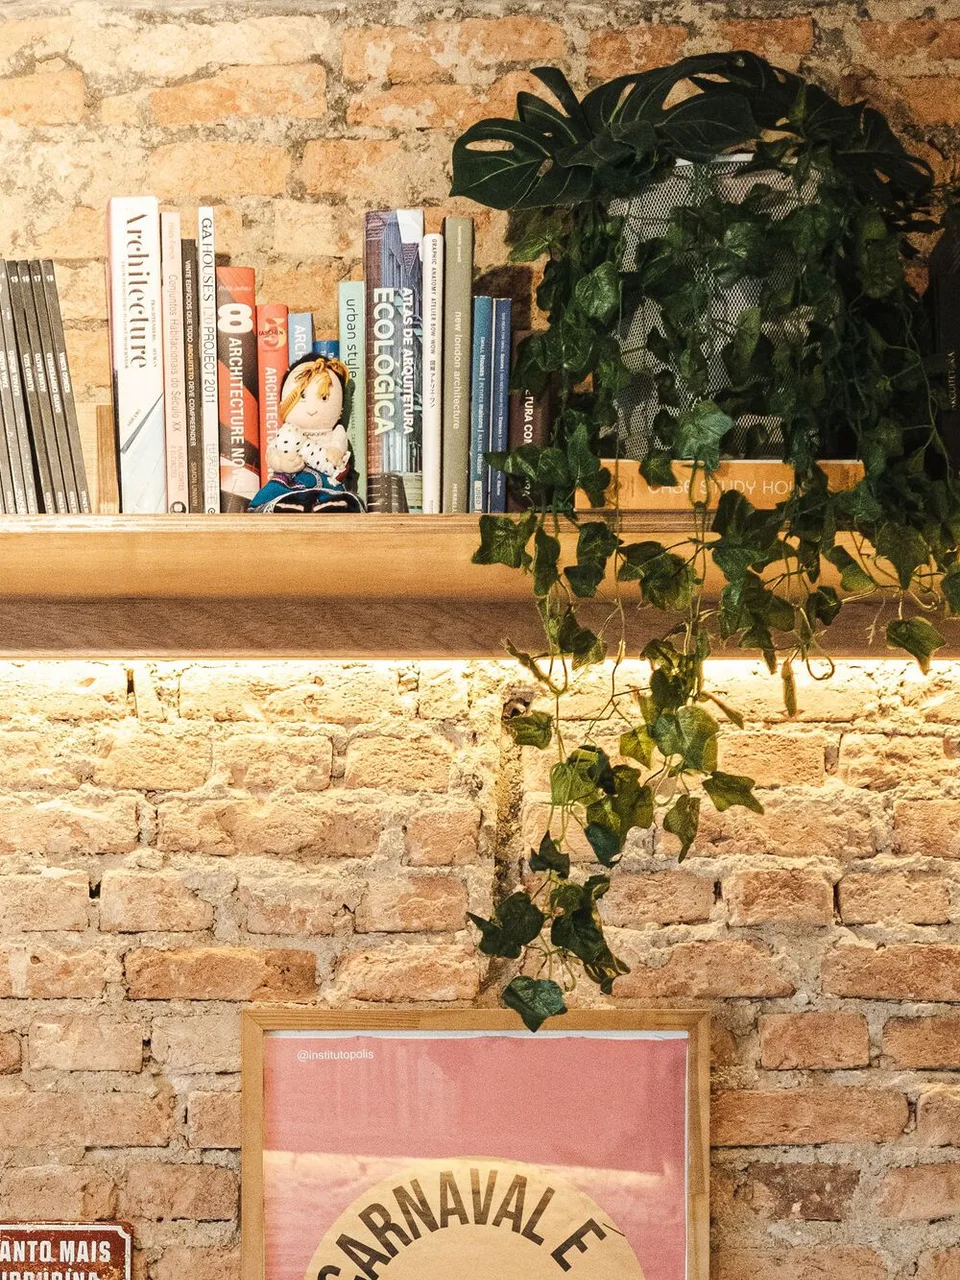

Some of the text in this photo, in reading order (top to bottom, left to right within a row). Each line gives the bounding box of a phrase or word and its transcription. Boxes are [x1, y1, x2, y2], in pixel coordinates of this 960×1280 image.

[201, 218, 213, 241] GA
[184, 260, 192, 279] VINTE
[202, 243, 214, 302] HOUSES
[126, 214, 151, 369] Architecture
[185, 279, 193, 310] EDIFÍCIOS
[217, 302, 253, 334] 8
[346, 298, 359, 339] urban
[166, 274, 181, 433] Conjuntos Habitacionais do Século XX
[186, 343, 195, 380] ARQUITETO
[203, 326, 216, 375] PROJECT
[344, 344, 360, 379] style
[373, 287, 400, 436] ECOLÓGICA
[402, 287, 413, 435] ATLAS DE ARQUITETURA
[452, 312, 462, 429] new london architecture
[187, 381, 195, 398] DEVE
[204, 379, 215, 404] 2011
[228, 337, 245, 444] ARCHITECTURE
[188, 398, 197, 447] COMPREENDER
[190, 462, 198, 484] SIMON
[700, 480, 757, 494] STUDY
[297, 1049, 374, 1063] @institutopolis
[59, 1240, 111, 1263] MAIS
